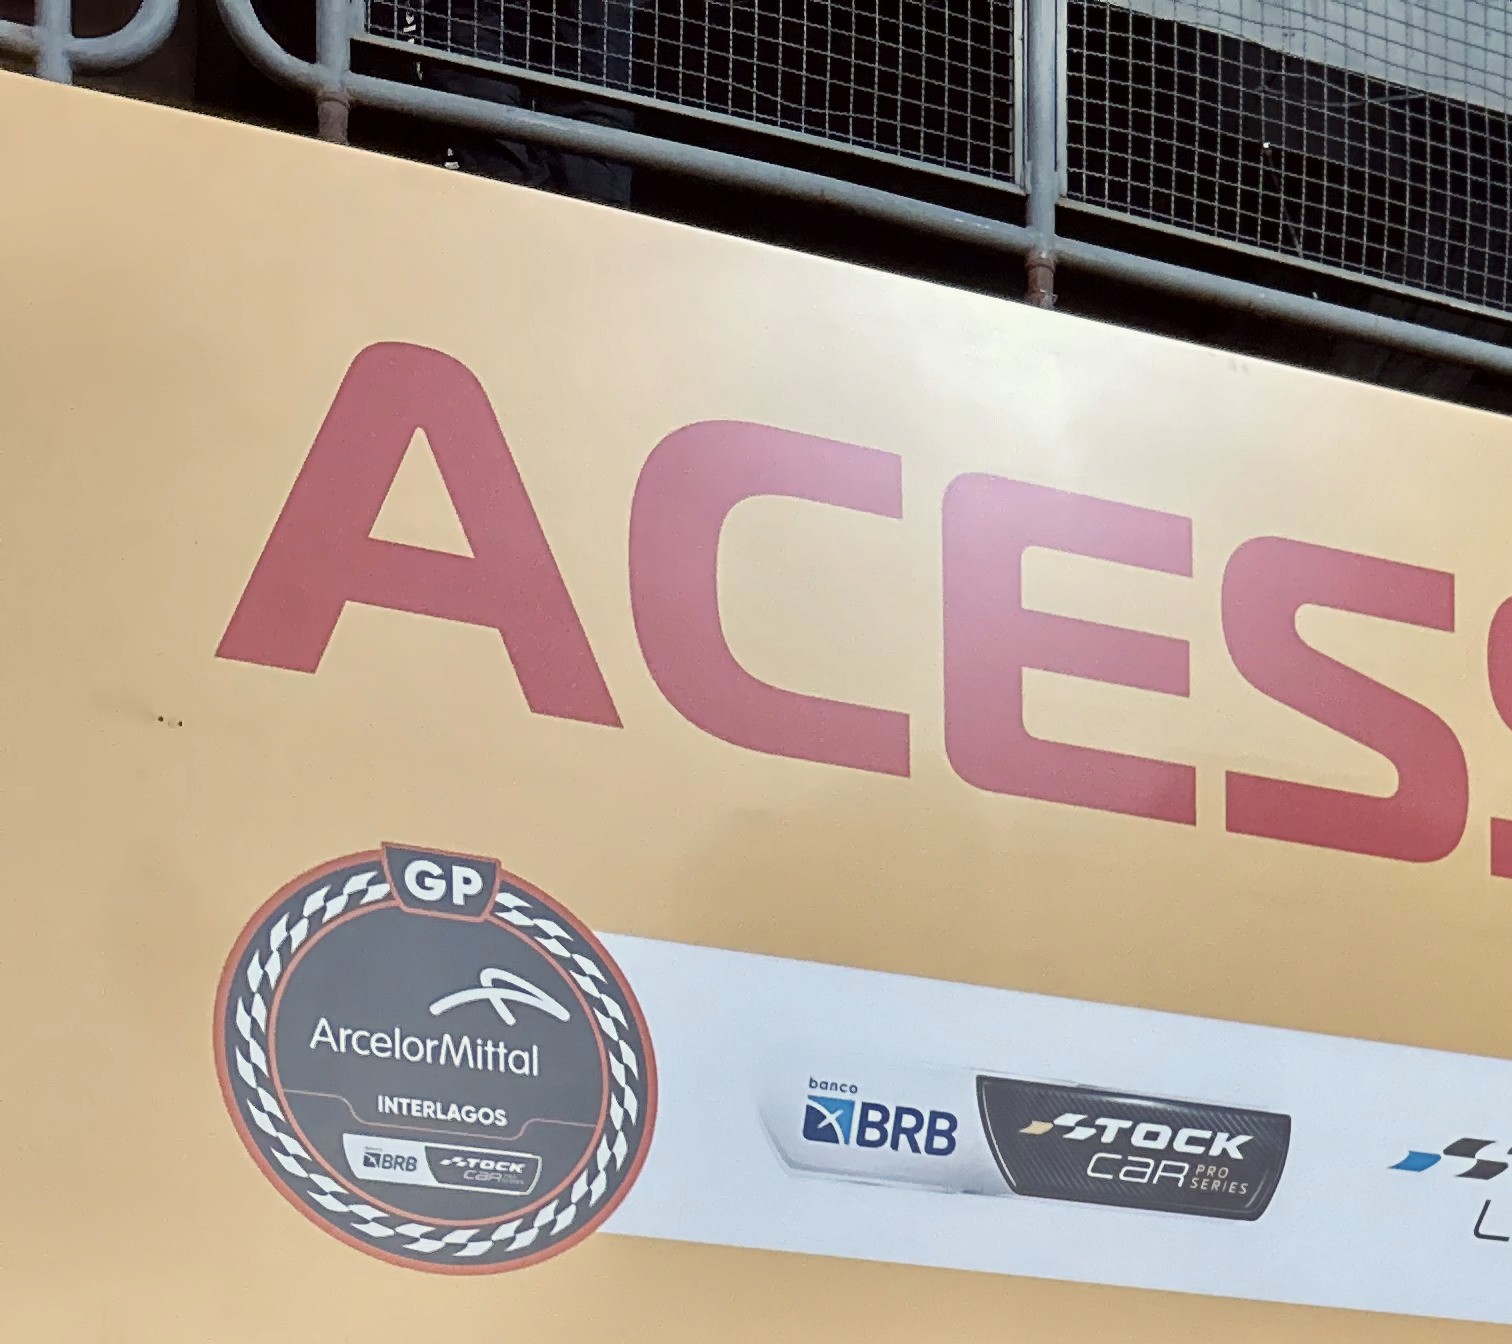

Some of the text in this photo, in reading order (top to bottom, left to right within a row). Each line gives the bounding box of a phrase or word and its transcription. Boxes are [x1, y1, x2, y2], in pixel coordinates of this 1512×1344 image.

[403, 859, 483, 906] GP
[309, 1016, 540, 1077] ArcelorMittal
[808, 1075, 859, 1095] banco
[376, 1094, 509, 1127] INTERLAGOS
[855, 1101, 959, 1157] BRB
[1048, 1111, 1256, 1161] STOCK
[381, 1154, 418, 1172] BRB
[447, 1156, 526, 1174] STOCK
[1195, 1163, 1230, 1178] PRO
[1189, 1176, 1249, 1195] SERIES
